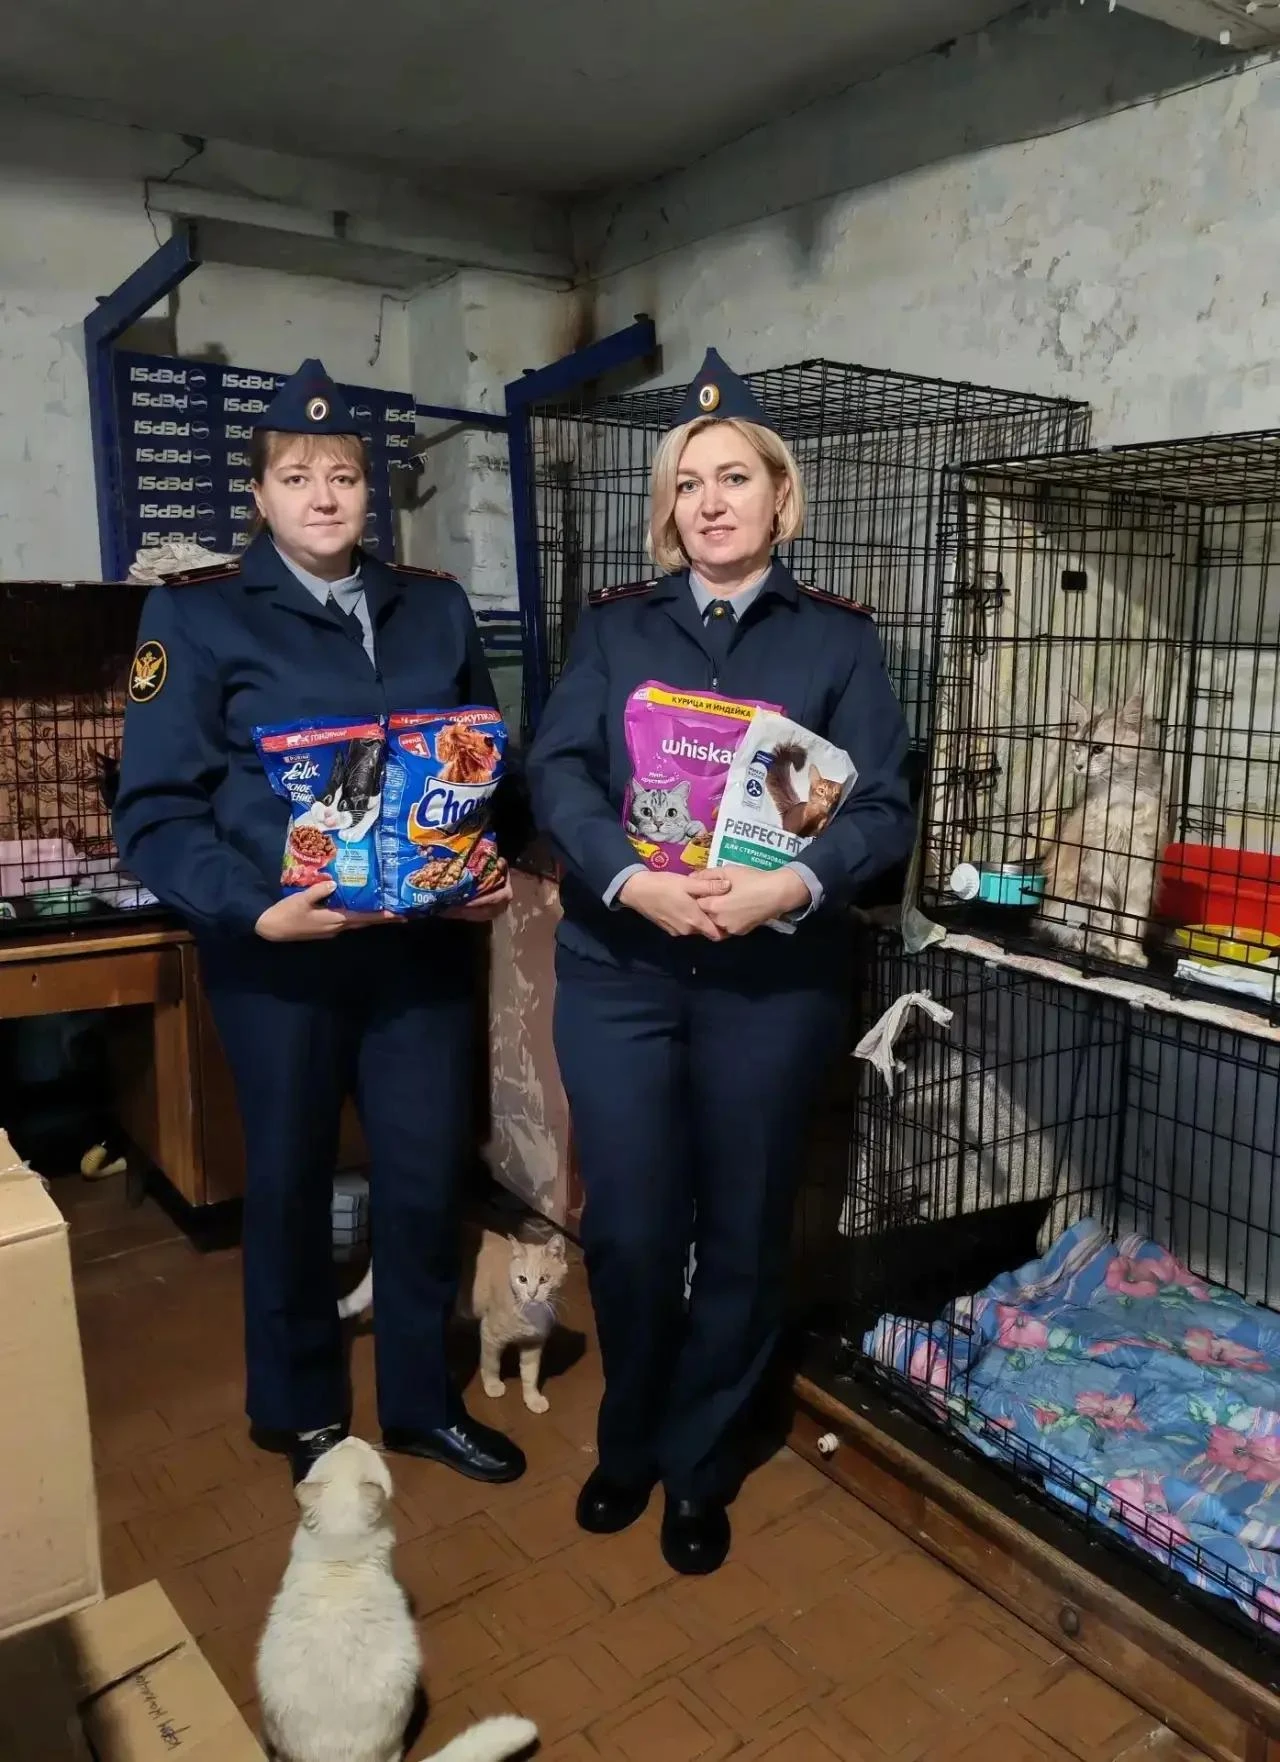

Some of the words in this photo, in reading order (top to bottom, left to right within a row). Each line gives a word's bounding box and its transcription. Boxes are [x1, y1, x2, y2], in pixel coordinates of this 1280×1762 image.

[130, 367, 187, 385] PEPSI
[222, 373, 274, 391] PEPSI
[132, 392, 188, 410] PEPSI
[134, 420, 190, 437] PEPSI
[136, 448, 192, 465] PEPSI
[138, 476, 194, 492] PEPSI
[140, 503, 196, 520] PEPSI
[142, 531, 198, 547] PEPSI
[724, 818, 784, 847] PERFECT
[786, 837, 802, 853] FIT
